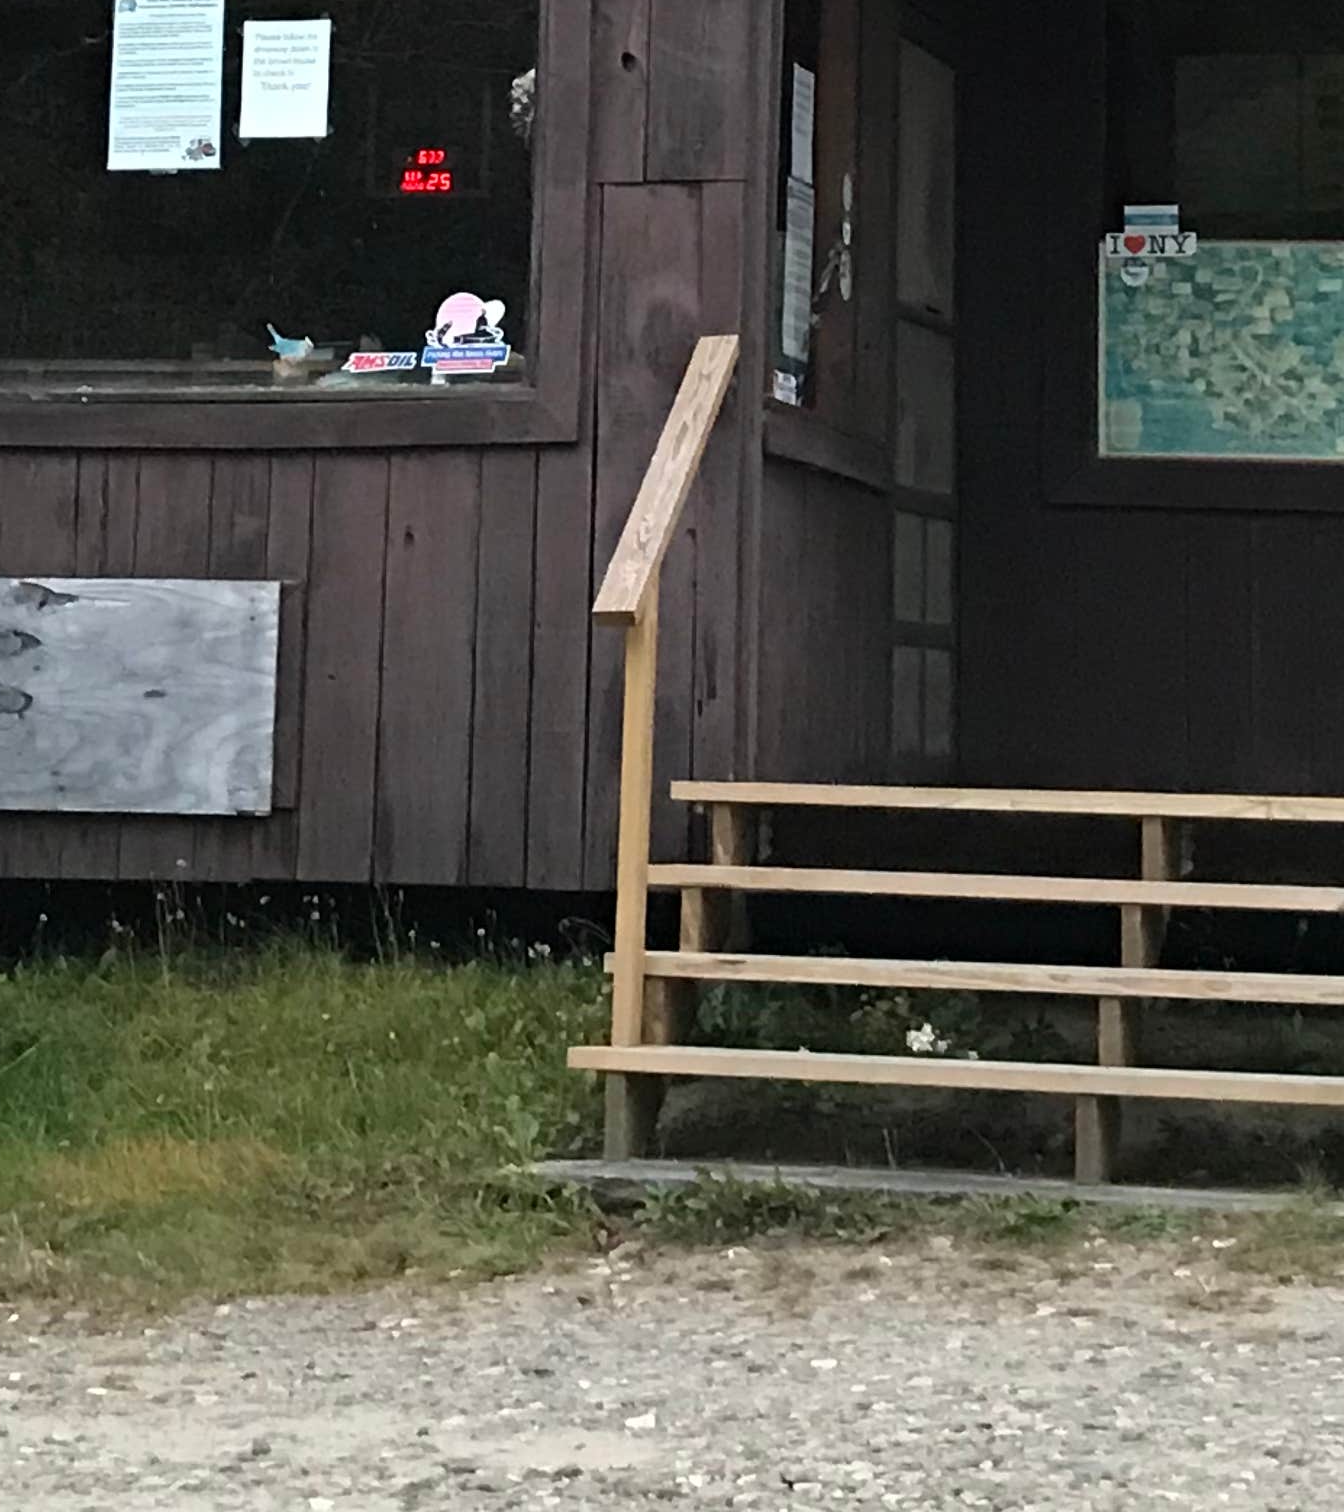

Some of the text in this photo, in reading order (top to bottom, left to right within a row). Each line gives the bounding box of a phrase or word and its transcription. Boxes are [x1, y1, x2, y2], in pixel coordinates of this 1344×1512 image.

[1109, 234, 1191, 254] I NY
[350, 353, 415, 370] AMSOIL
